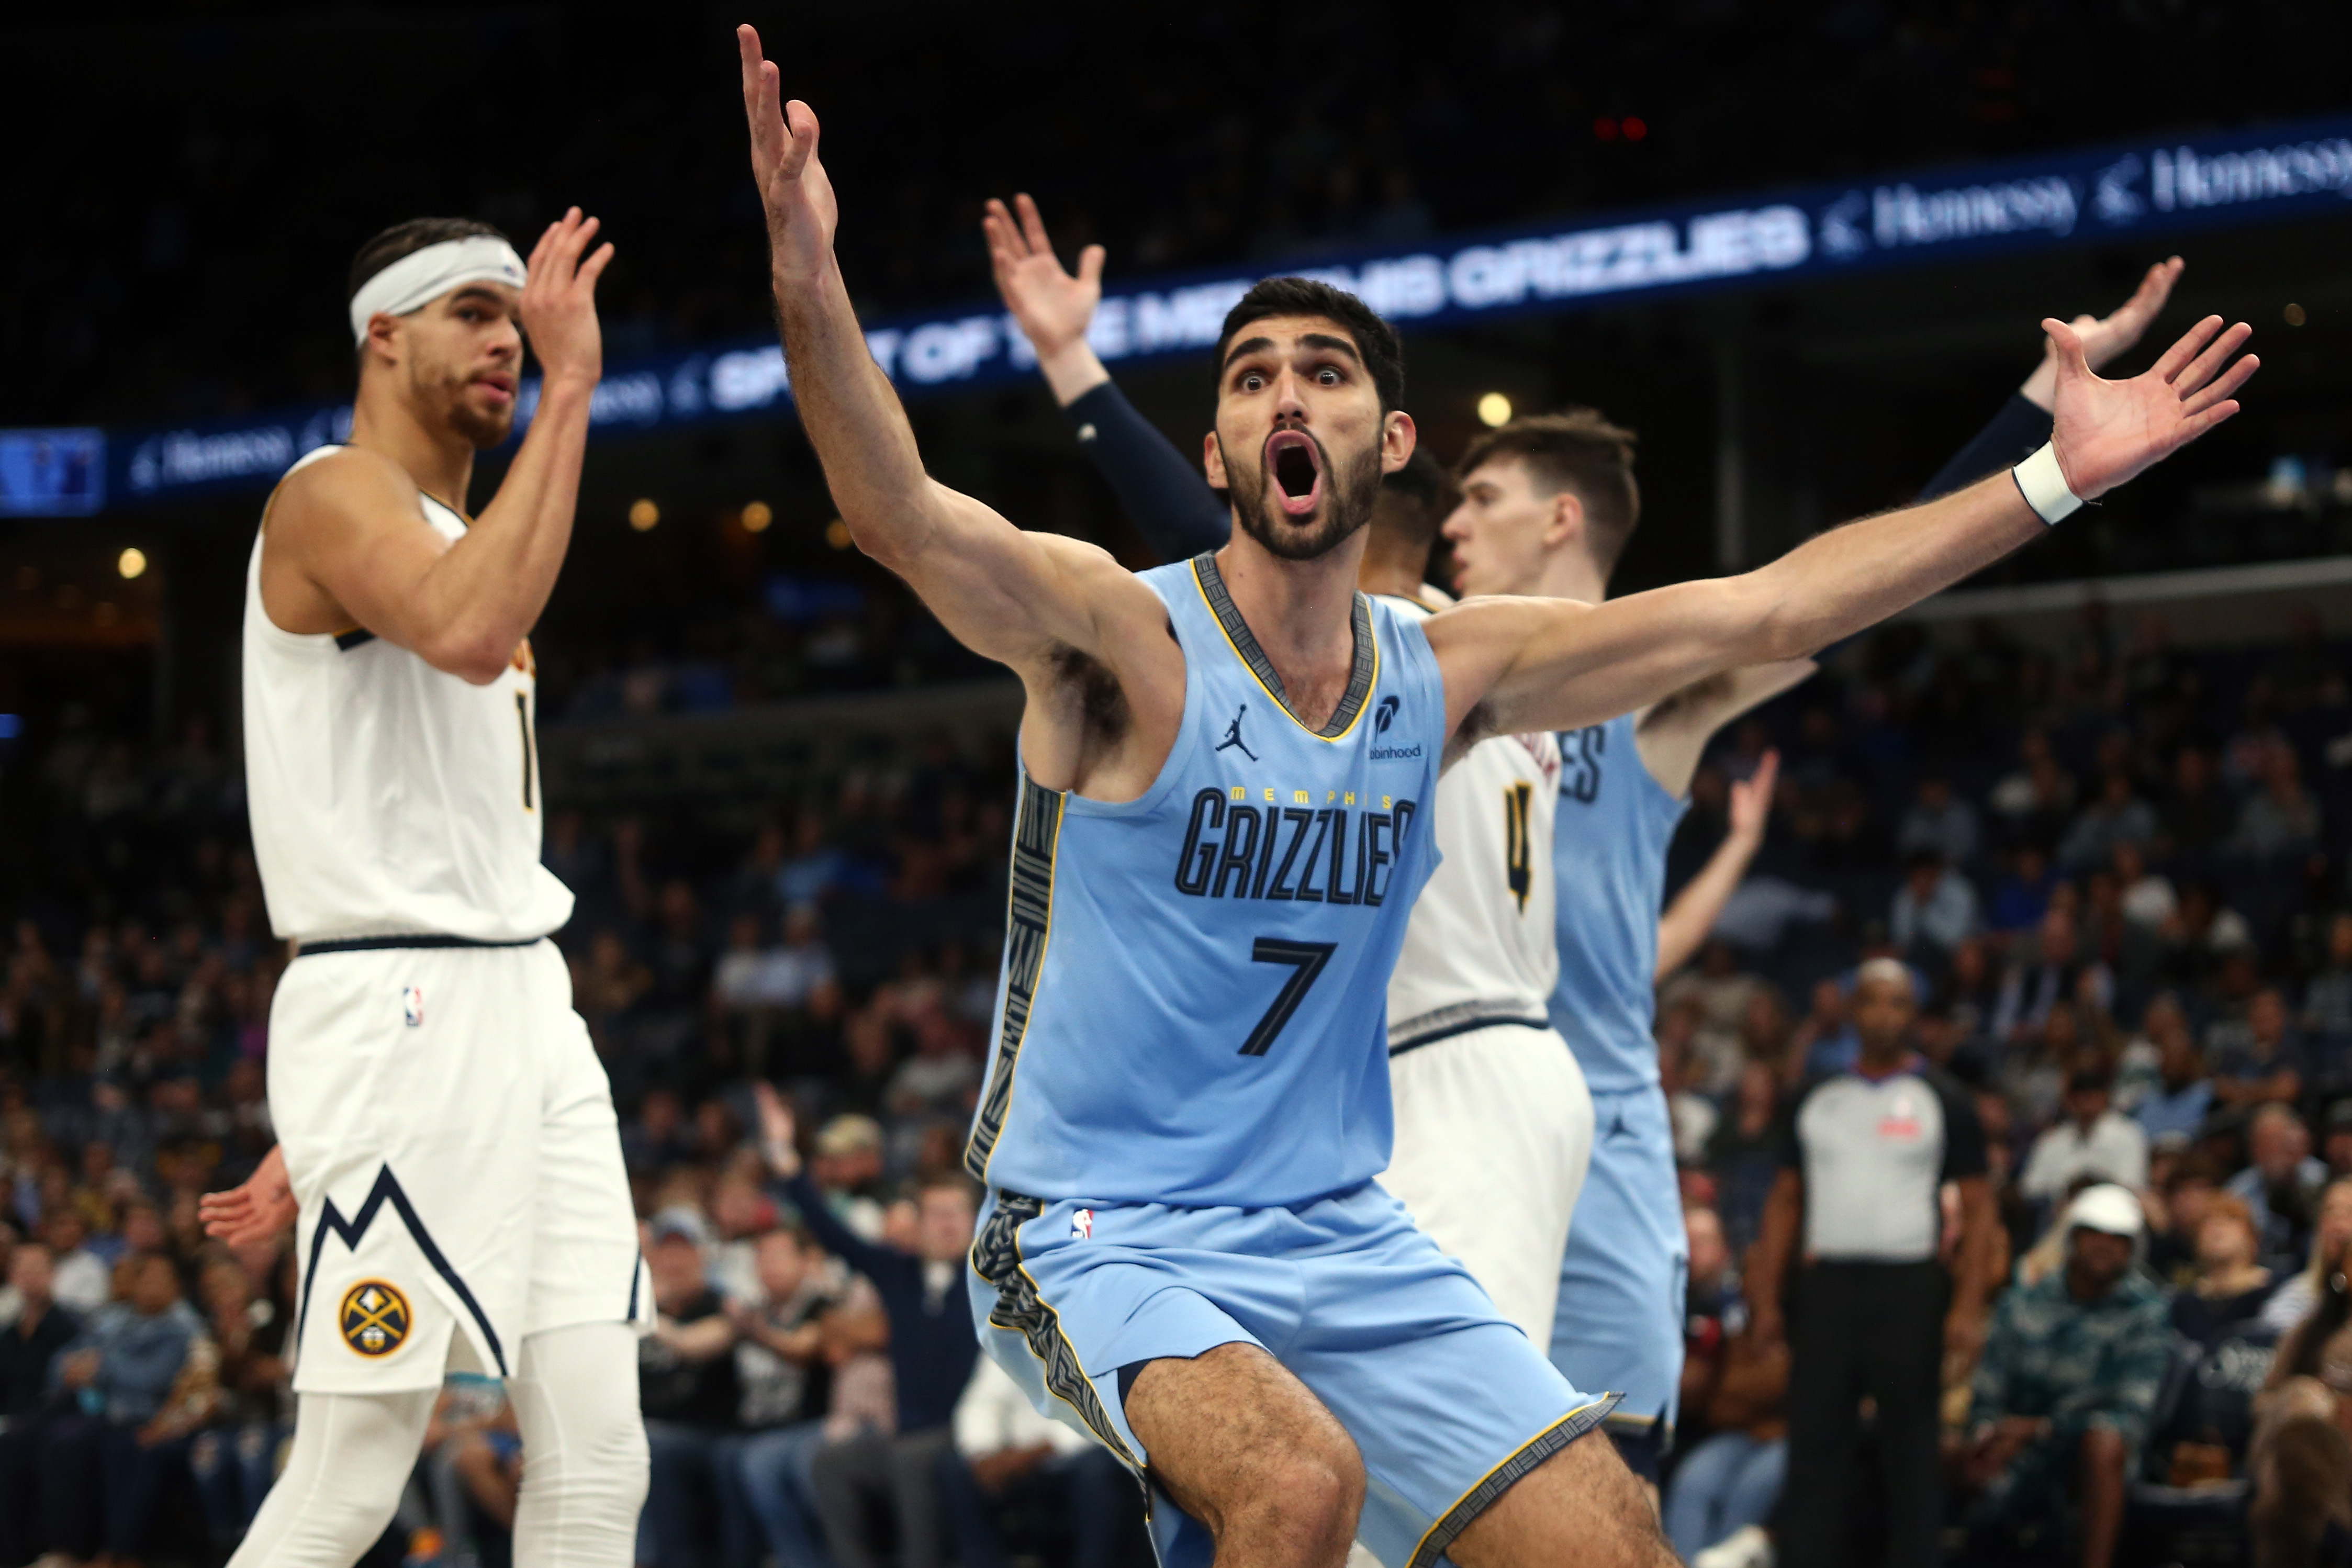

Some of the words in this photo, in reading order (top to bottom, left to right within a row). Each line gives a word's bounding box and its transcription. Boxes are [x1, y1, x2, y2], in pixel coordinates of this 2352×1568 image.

[1449, 204, 1812, 310] GRIZZLIES
[1370, 744, 1421, 760] obinhood
[1230, 786, 1392, 809] MEMPHIS
[1237, 937, 1338, 1056] 7
